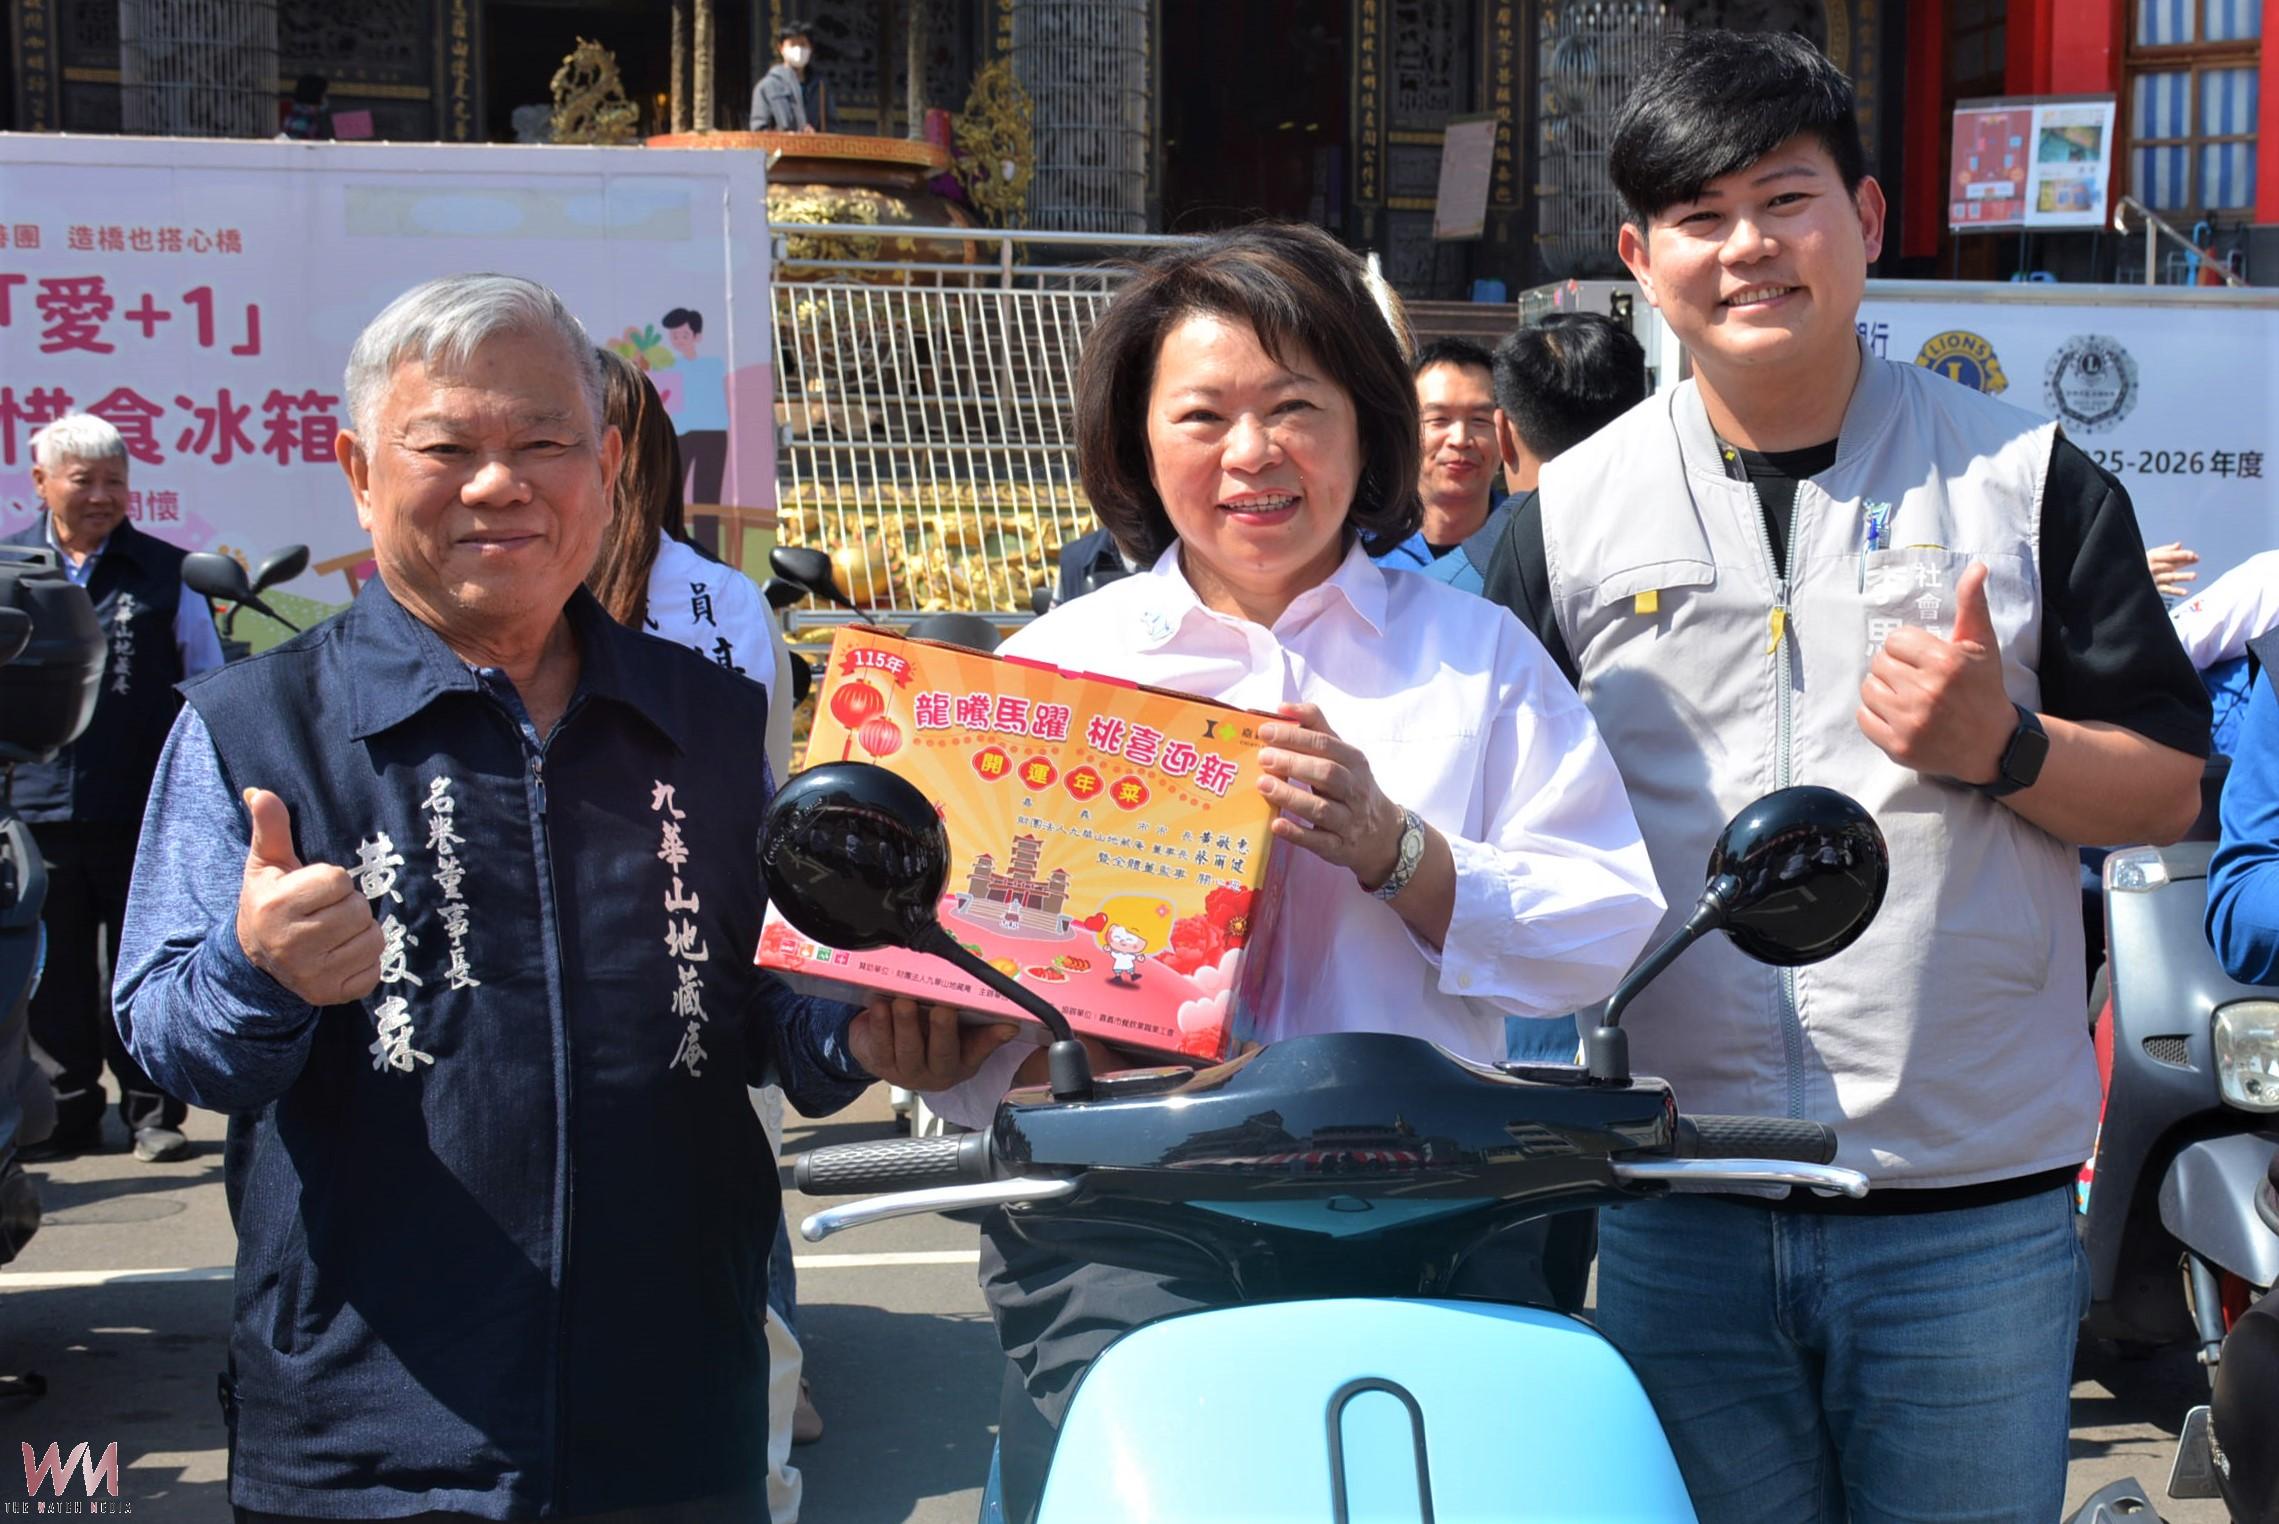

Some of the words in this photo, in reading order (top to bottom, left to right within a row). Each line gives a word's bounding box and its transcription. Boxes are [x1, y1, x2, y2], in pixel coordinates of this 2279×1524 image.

[68, 225, 243, 253] 造橋也搭心橋
[1928, 333, 1987, 357] LIONS
[1915, 562, 1943, 631] 社會
[854, 651, 905, 674] 115年
[981, 751, 1142, 804] 開運年菜
[1086, 714, 1239, 797] 桃喜迎新
[421, 776, 481, 990] 名譽董事長
[650, 779, 709, 1077] 九華山地藏庵
